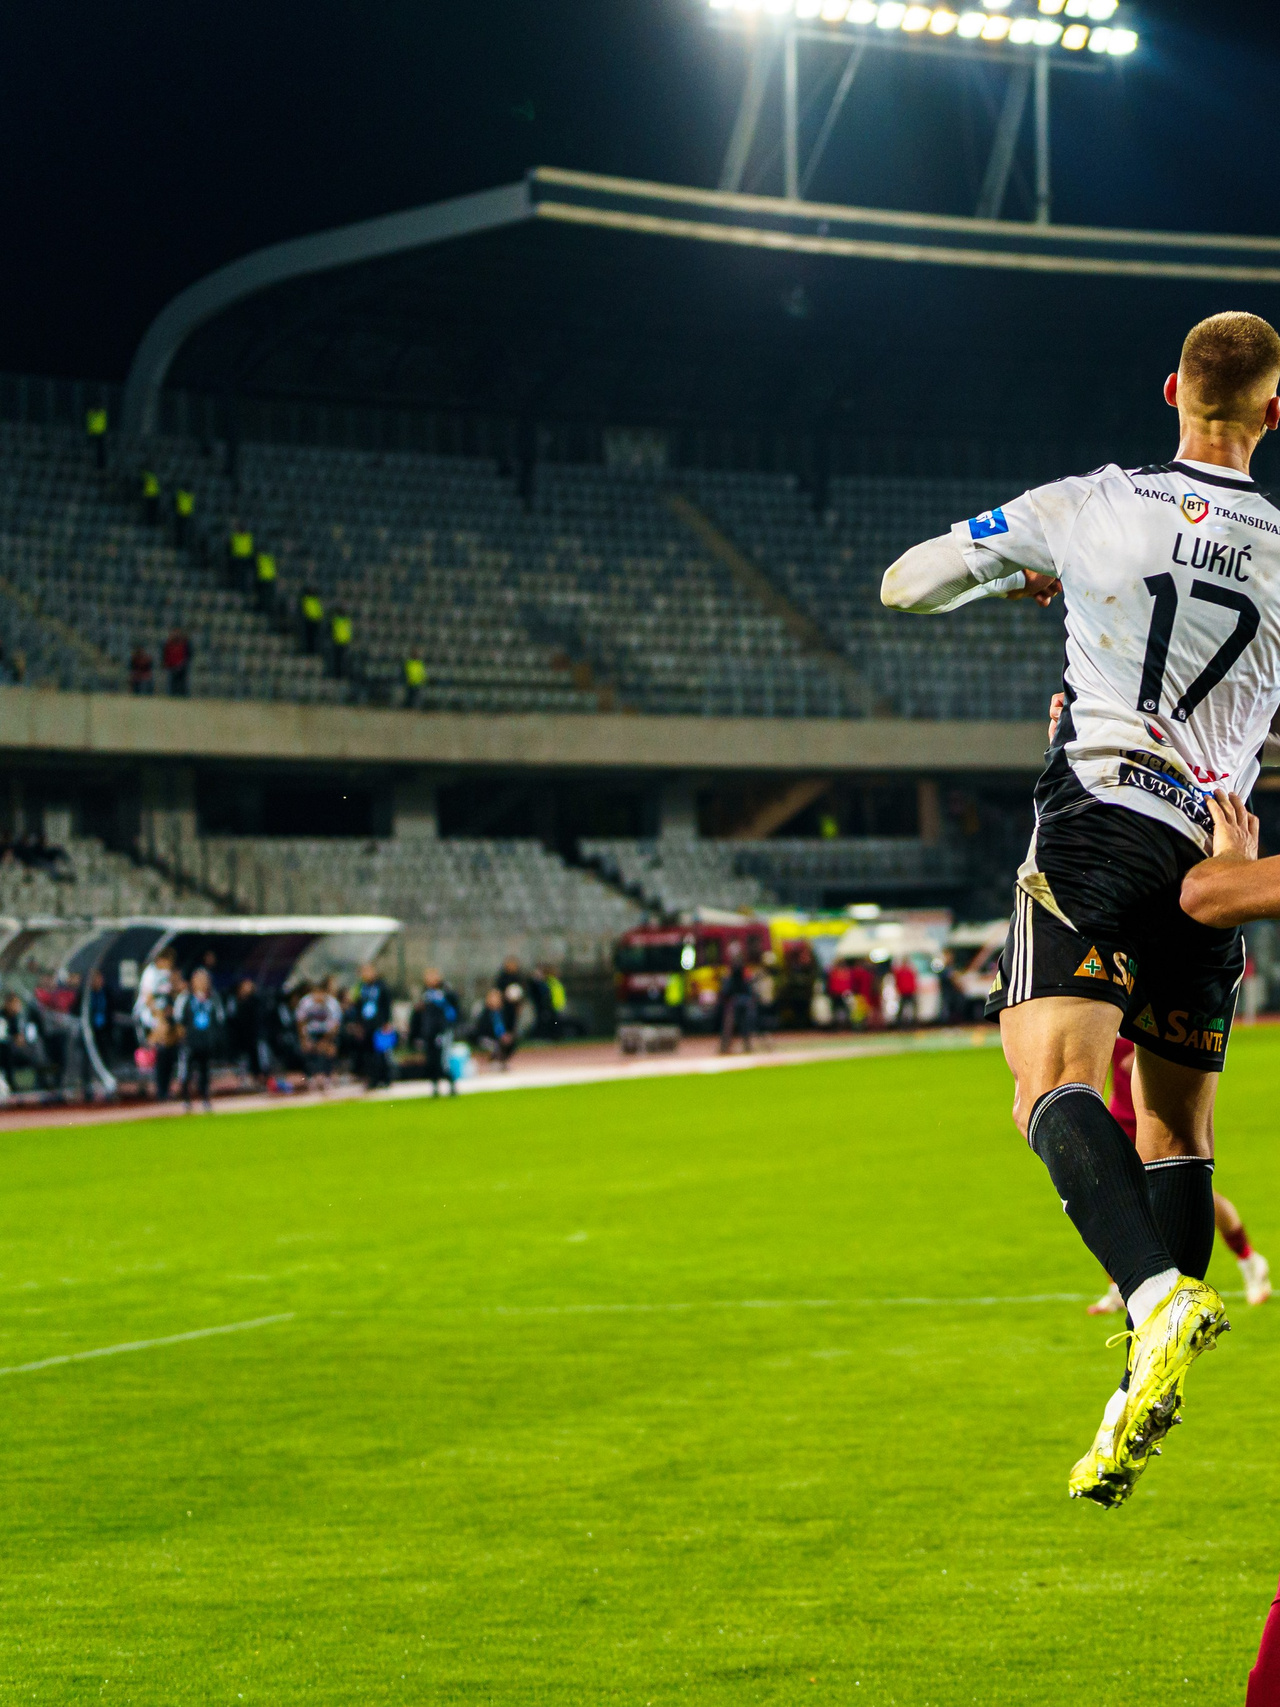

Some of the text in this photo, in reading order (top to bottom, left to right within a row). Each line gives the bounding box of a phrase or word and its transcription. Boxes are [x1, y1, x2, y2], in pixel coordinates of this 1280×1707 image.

[1134, 487, 1177, 505] BANCA
[1187, 500, 1204, 512] BT
[1172, 532, 1252, 582] LUKIĆ
[1136, 571, 1261, 724] 17
[1164, 1009, 1224, 1053] SANTE
